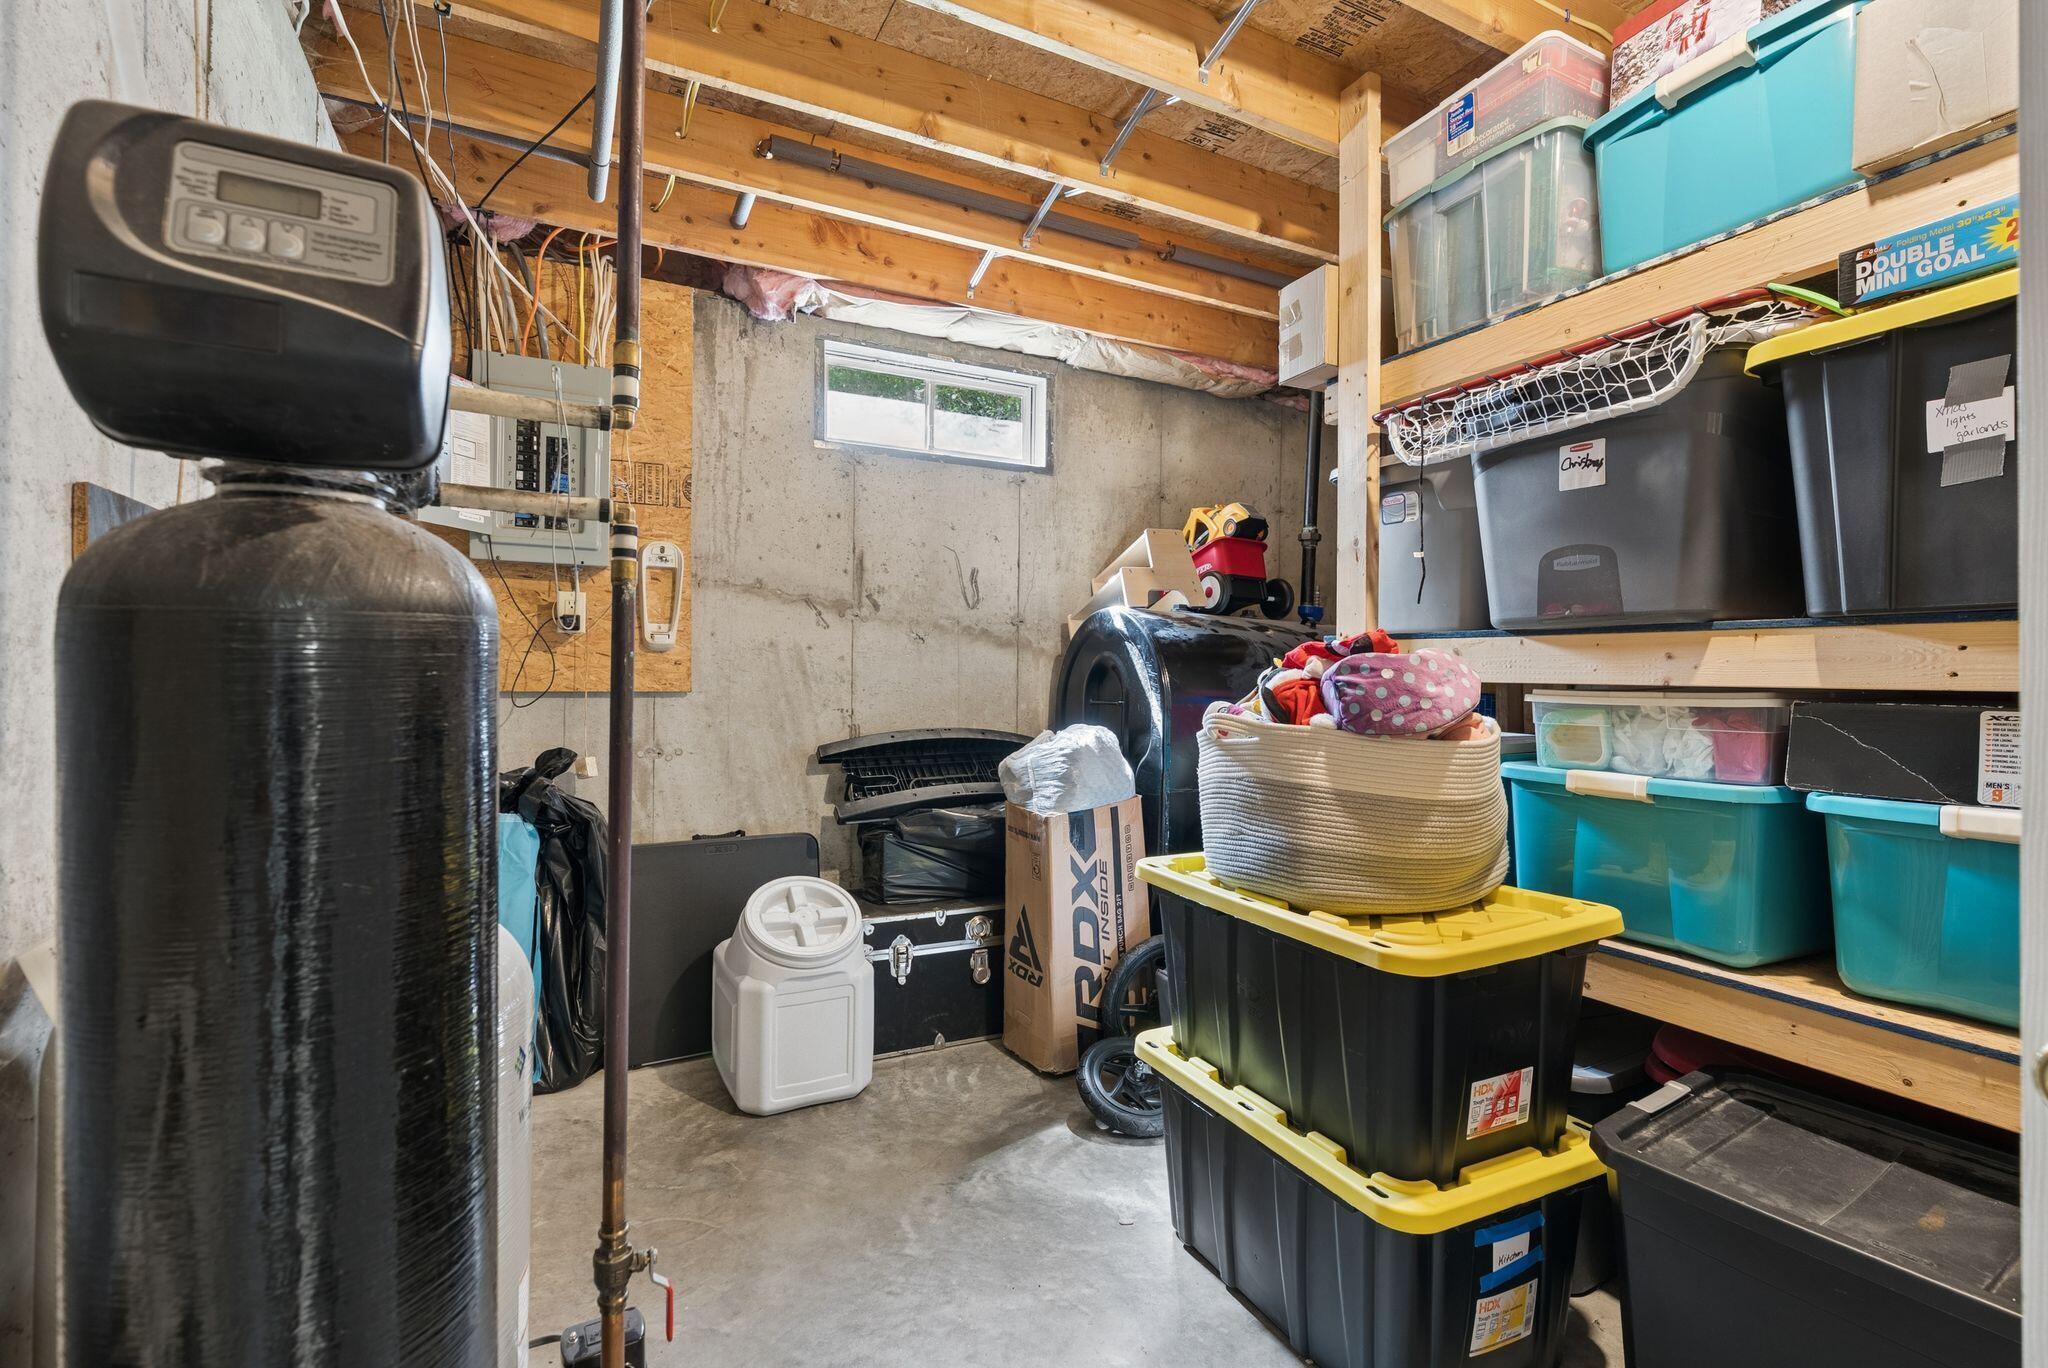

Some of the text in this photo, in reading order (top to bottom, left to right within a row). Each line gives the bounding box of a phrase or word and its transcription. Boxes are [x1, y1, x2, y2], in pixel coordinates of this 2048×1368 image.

[1896, 234, 1928, 248] Folding
[1929, 223, 1955, 237] Metal
[1855, 233, 1956, 280] DOUBLE
[1855, 244, 1986, 297] MINI GOAL
[1935, 403, 1967, 418] Xmas
[1946, 411, 1977, 430] lights
[1956, 420, 2009, 443] garlands
[1985, 782, 2010, 790] MEN'S
[1992, 789, 2003, 802] 9
[1099, 858, 1111, 941] INSIDE
[1069, 854, 1103, 1022] RDX
[1116, 925, 1125, 951] PUNCH
[1008, 956, 1044, 988] RDX
[1473, 1082, 1495, 1097] HDX
[1478, 1299, 1501, 1314] HDX
